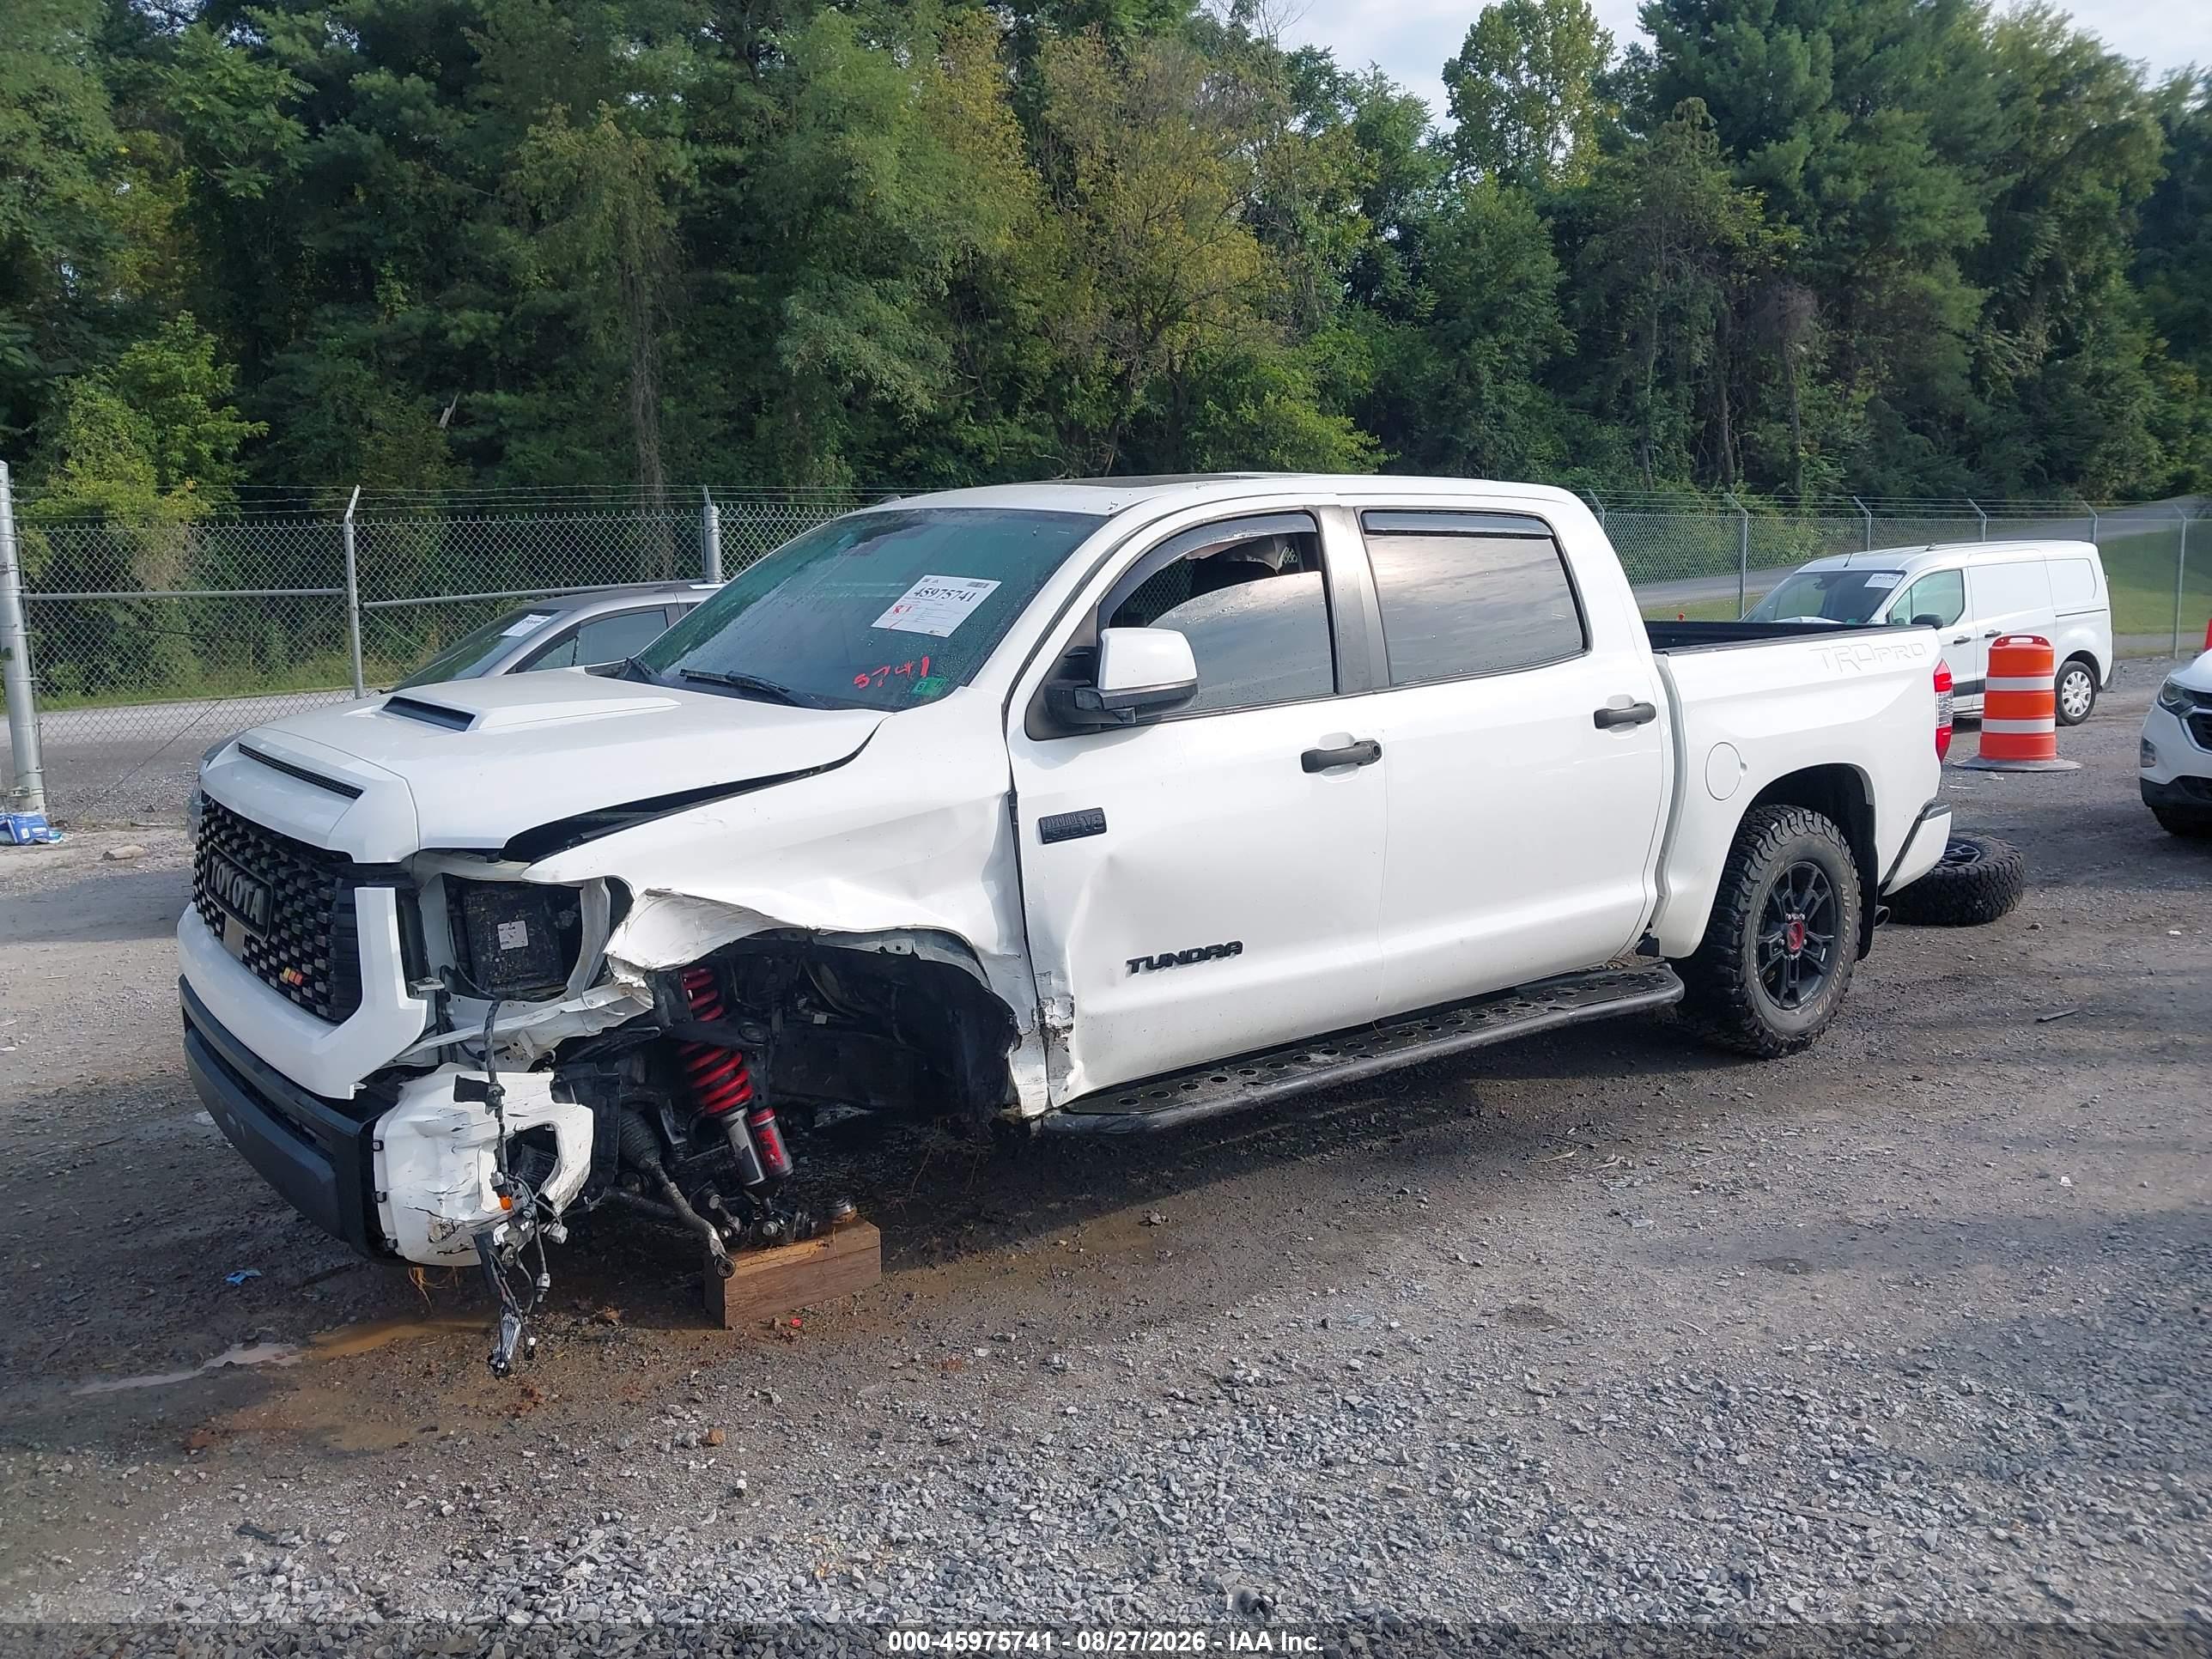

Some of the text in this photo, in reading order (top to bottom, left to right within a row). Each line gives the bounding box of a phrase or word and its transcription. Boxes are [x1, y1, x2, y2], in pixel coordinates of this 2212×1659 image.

[914, 586, 978, 603] 45975741
[854, 654, 930, 689] 5741
[1809, 642, 1927, 673] TRD PRO
[210, 854, 265, 925] TOYOTA
[1126, 940, 1243, 974] TUNDRA
